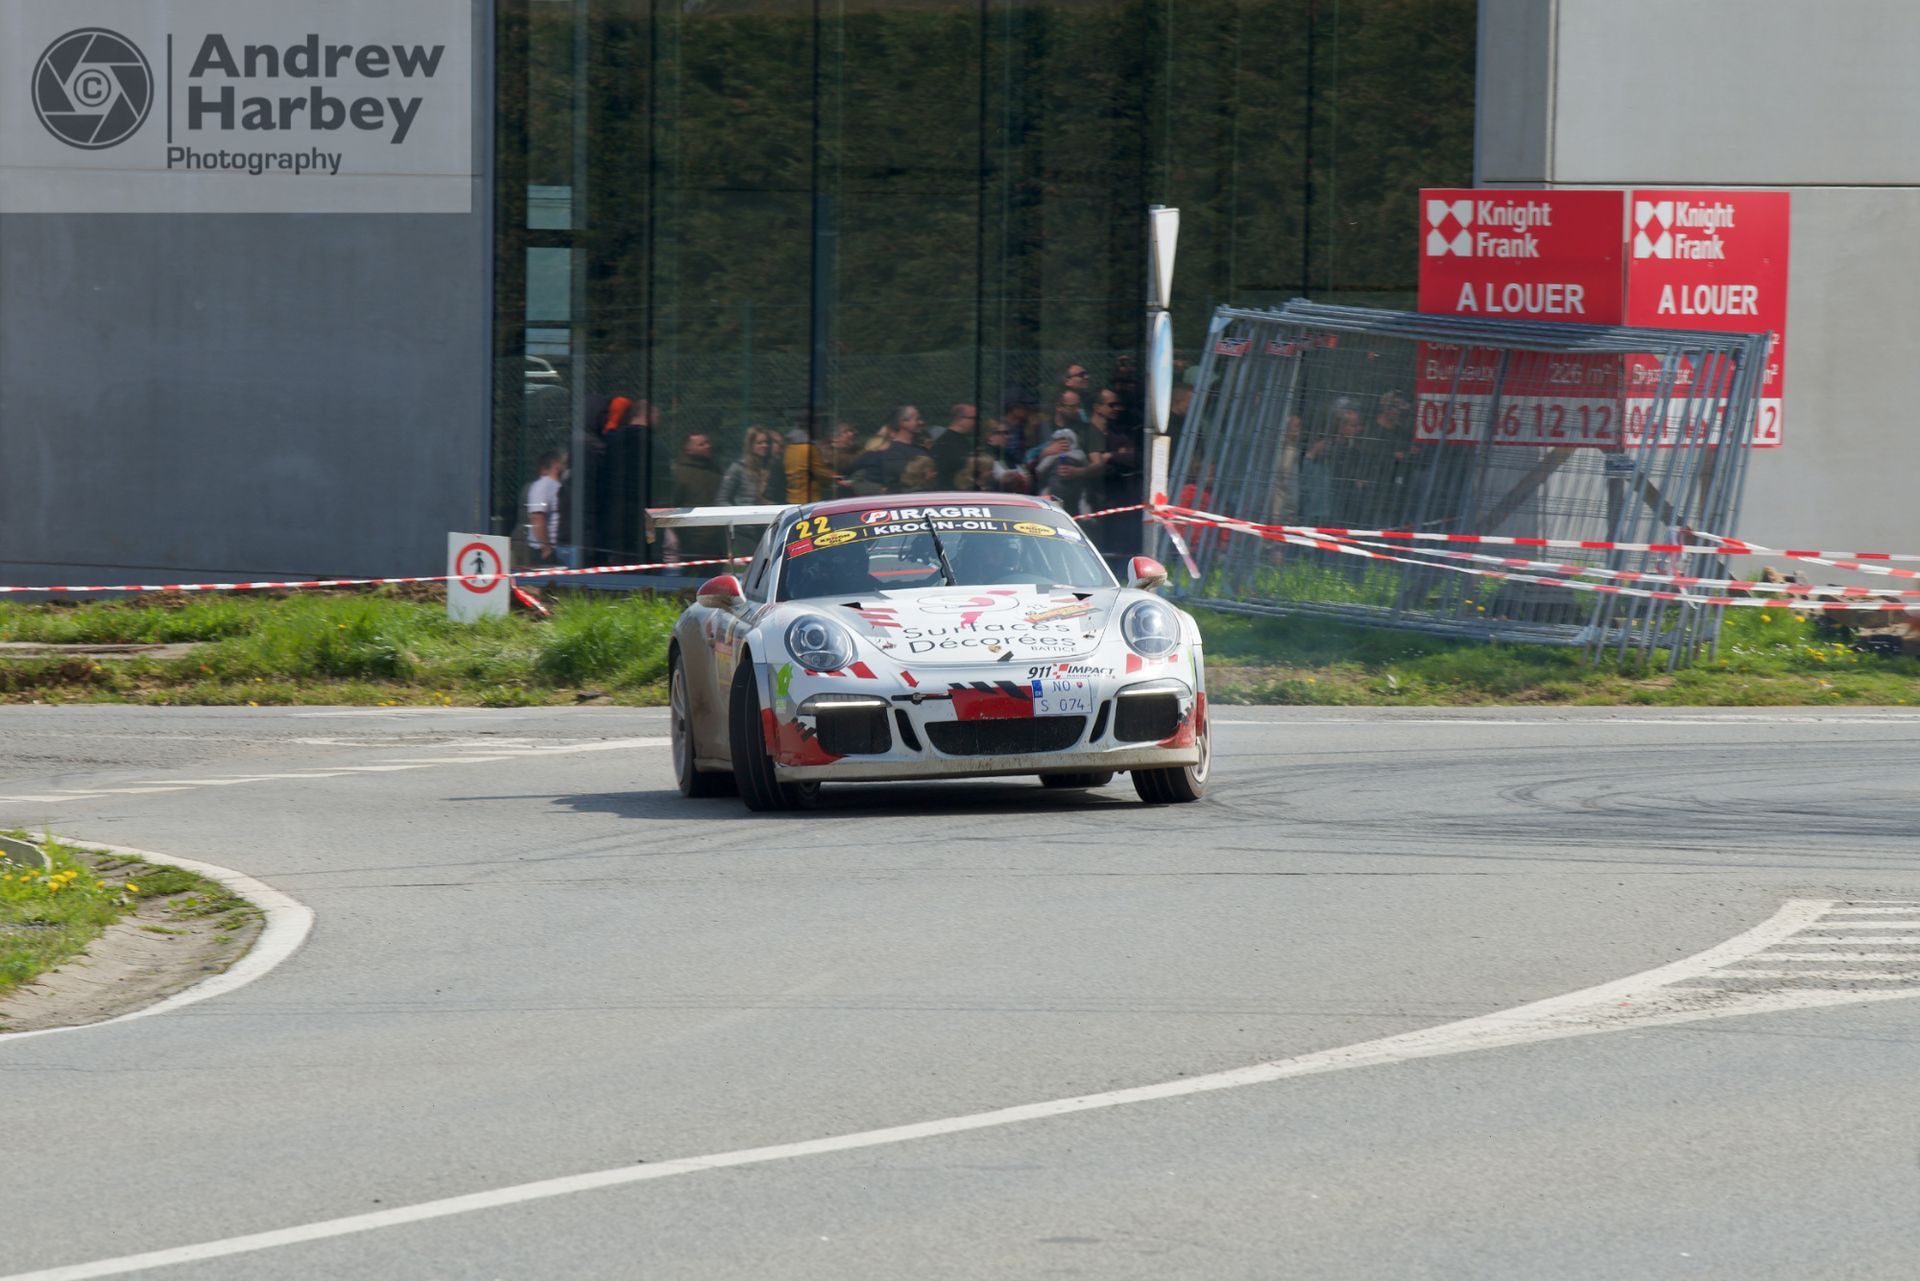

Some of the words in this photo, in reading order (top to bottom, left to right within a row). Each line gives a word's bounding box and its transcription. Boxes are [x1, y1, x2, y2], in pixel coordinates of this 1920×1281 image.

[1477, 199, 1552, 233] Knight
[1675, 200, 1735, 234] Knight
[1477, 232, 1541, 258] Frank
[1675, 233, 1725, 260] Frank
[1456, 282, 1478, 312] A
[1486, 282, 1585, 314] LOUER
[1657, 284, 1676, 314] A
[1681, 284, 1758, 316] LOUER
[1535, 403, 1565, 438] 12
[1578, 404, 1613, 439] 12
[796, 516, 831, 539] 22
[865, 507, 992, 525] PIRAGRI
[873, 521, 998, 535] KROON-OIL
[903, 620, 1072, 639] Surfaces
[908, 633, 1077, 654] Décorées
[1026, 665, 1051, 679] 911
[1067, 665, 1114, 675] IMPACT
[1053, 680, 1071, 692] NO
[1041, 699, 1049, 712] S
[1059, 698, 1084, 712] 074
